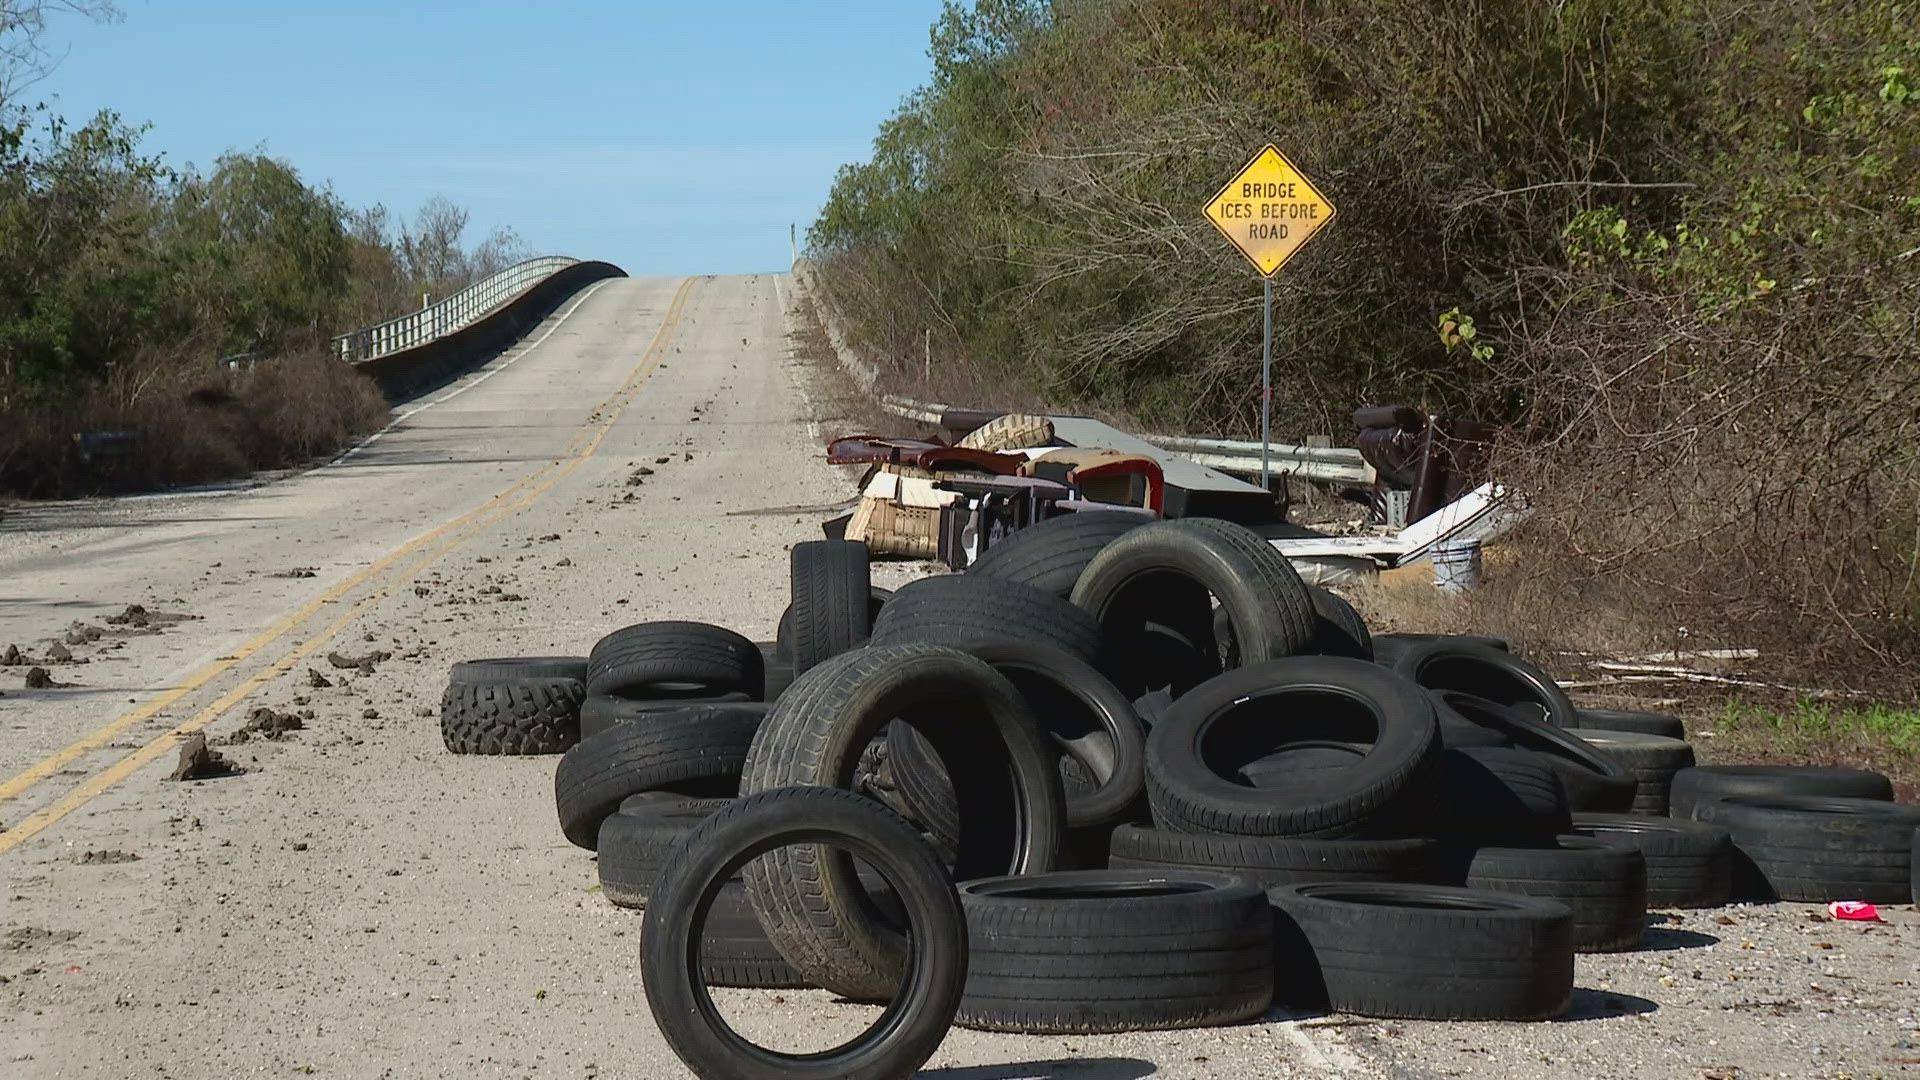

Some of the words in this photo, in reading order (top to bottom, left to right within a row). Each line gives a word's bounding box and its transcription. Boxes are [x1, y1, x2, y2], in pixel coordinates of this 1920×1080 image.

[1243, 183, 1296, 198] BRIDGE
[1221, 203, 1252, 218] ICES
[1261, 203, 1318, 219] BEFORE
[1249, 224, 1288, 239] ROAD
